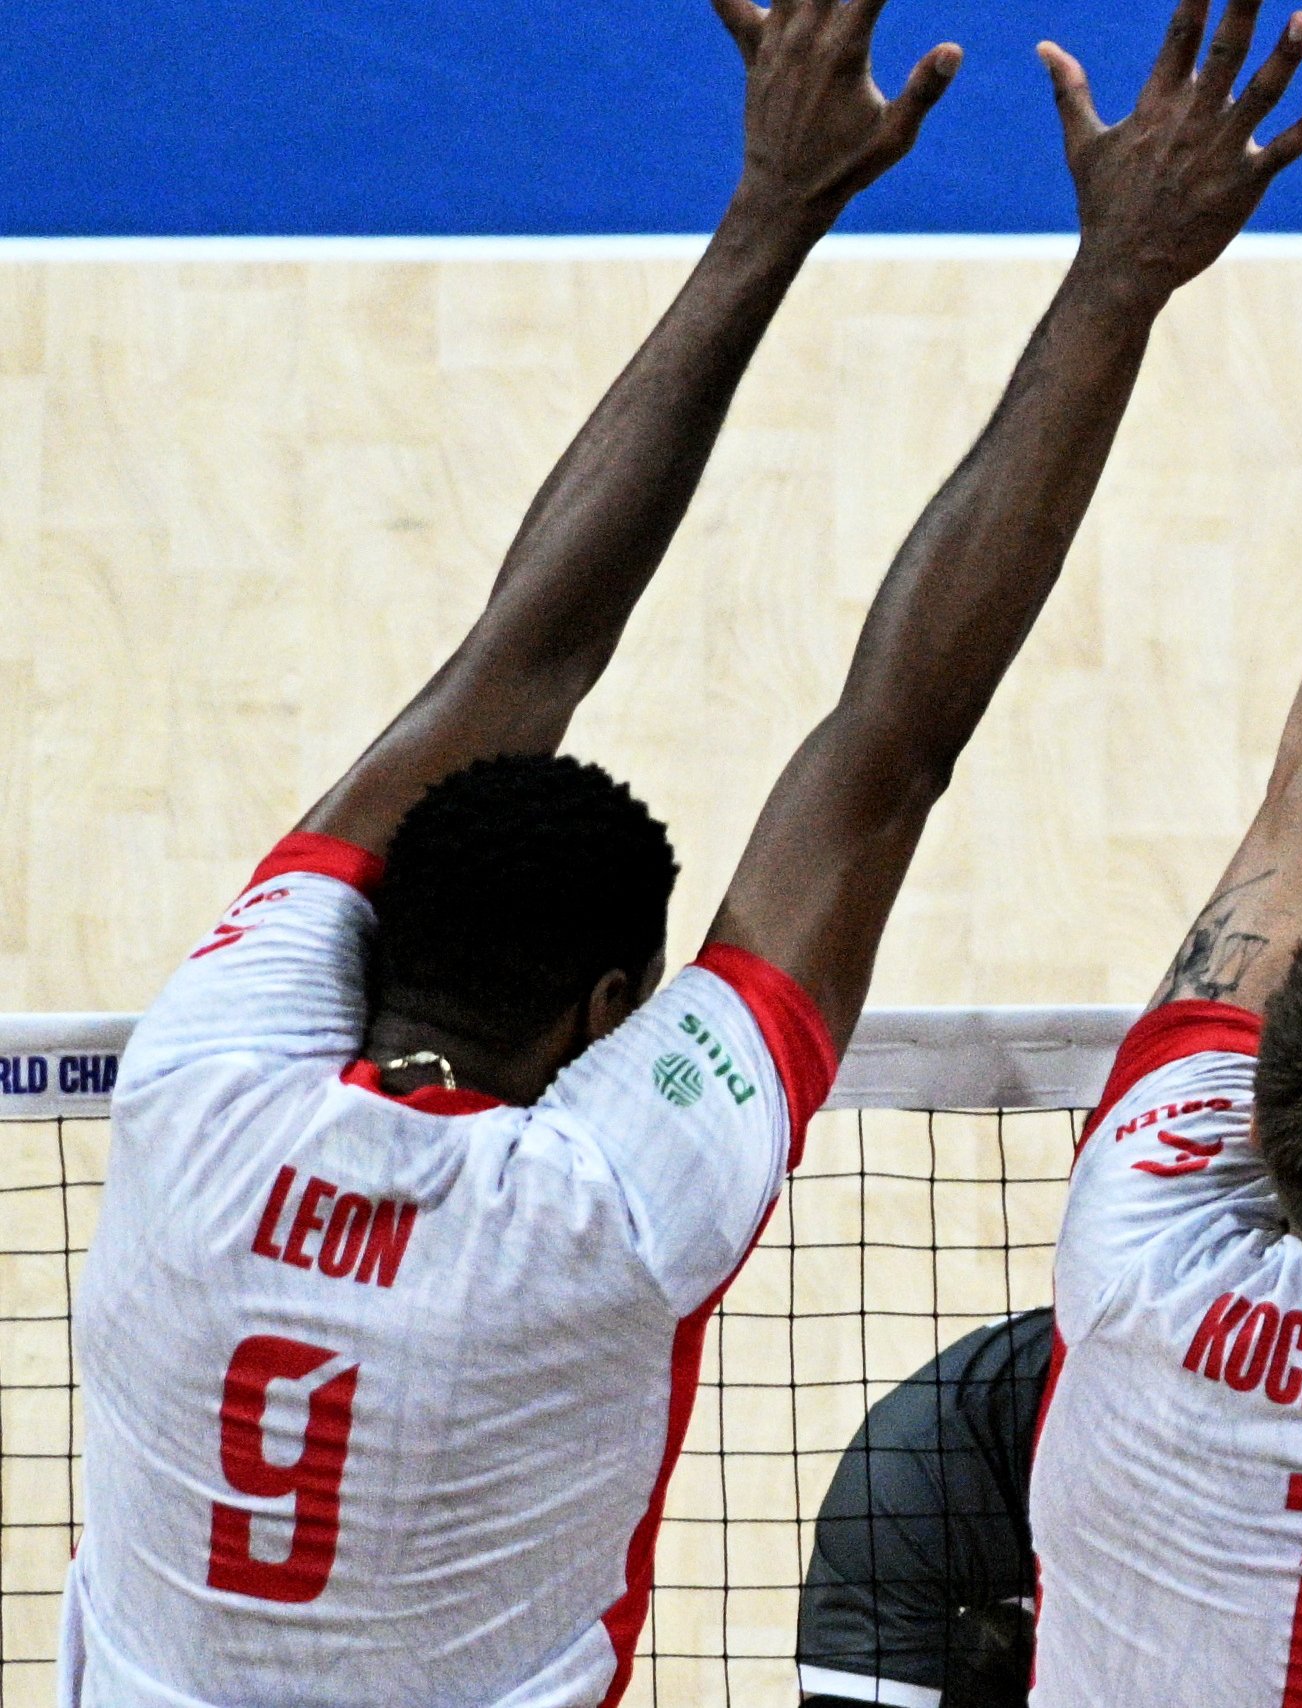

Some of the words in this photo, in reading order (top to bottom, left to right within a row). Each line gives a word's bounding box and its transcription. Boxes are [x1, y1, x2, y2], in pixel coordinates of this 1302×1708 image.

[678, 1013, 756, 1105] plus
[251, 1164, 418, 1288] LEON
[206, 1334, 361, 1604] 9
